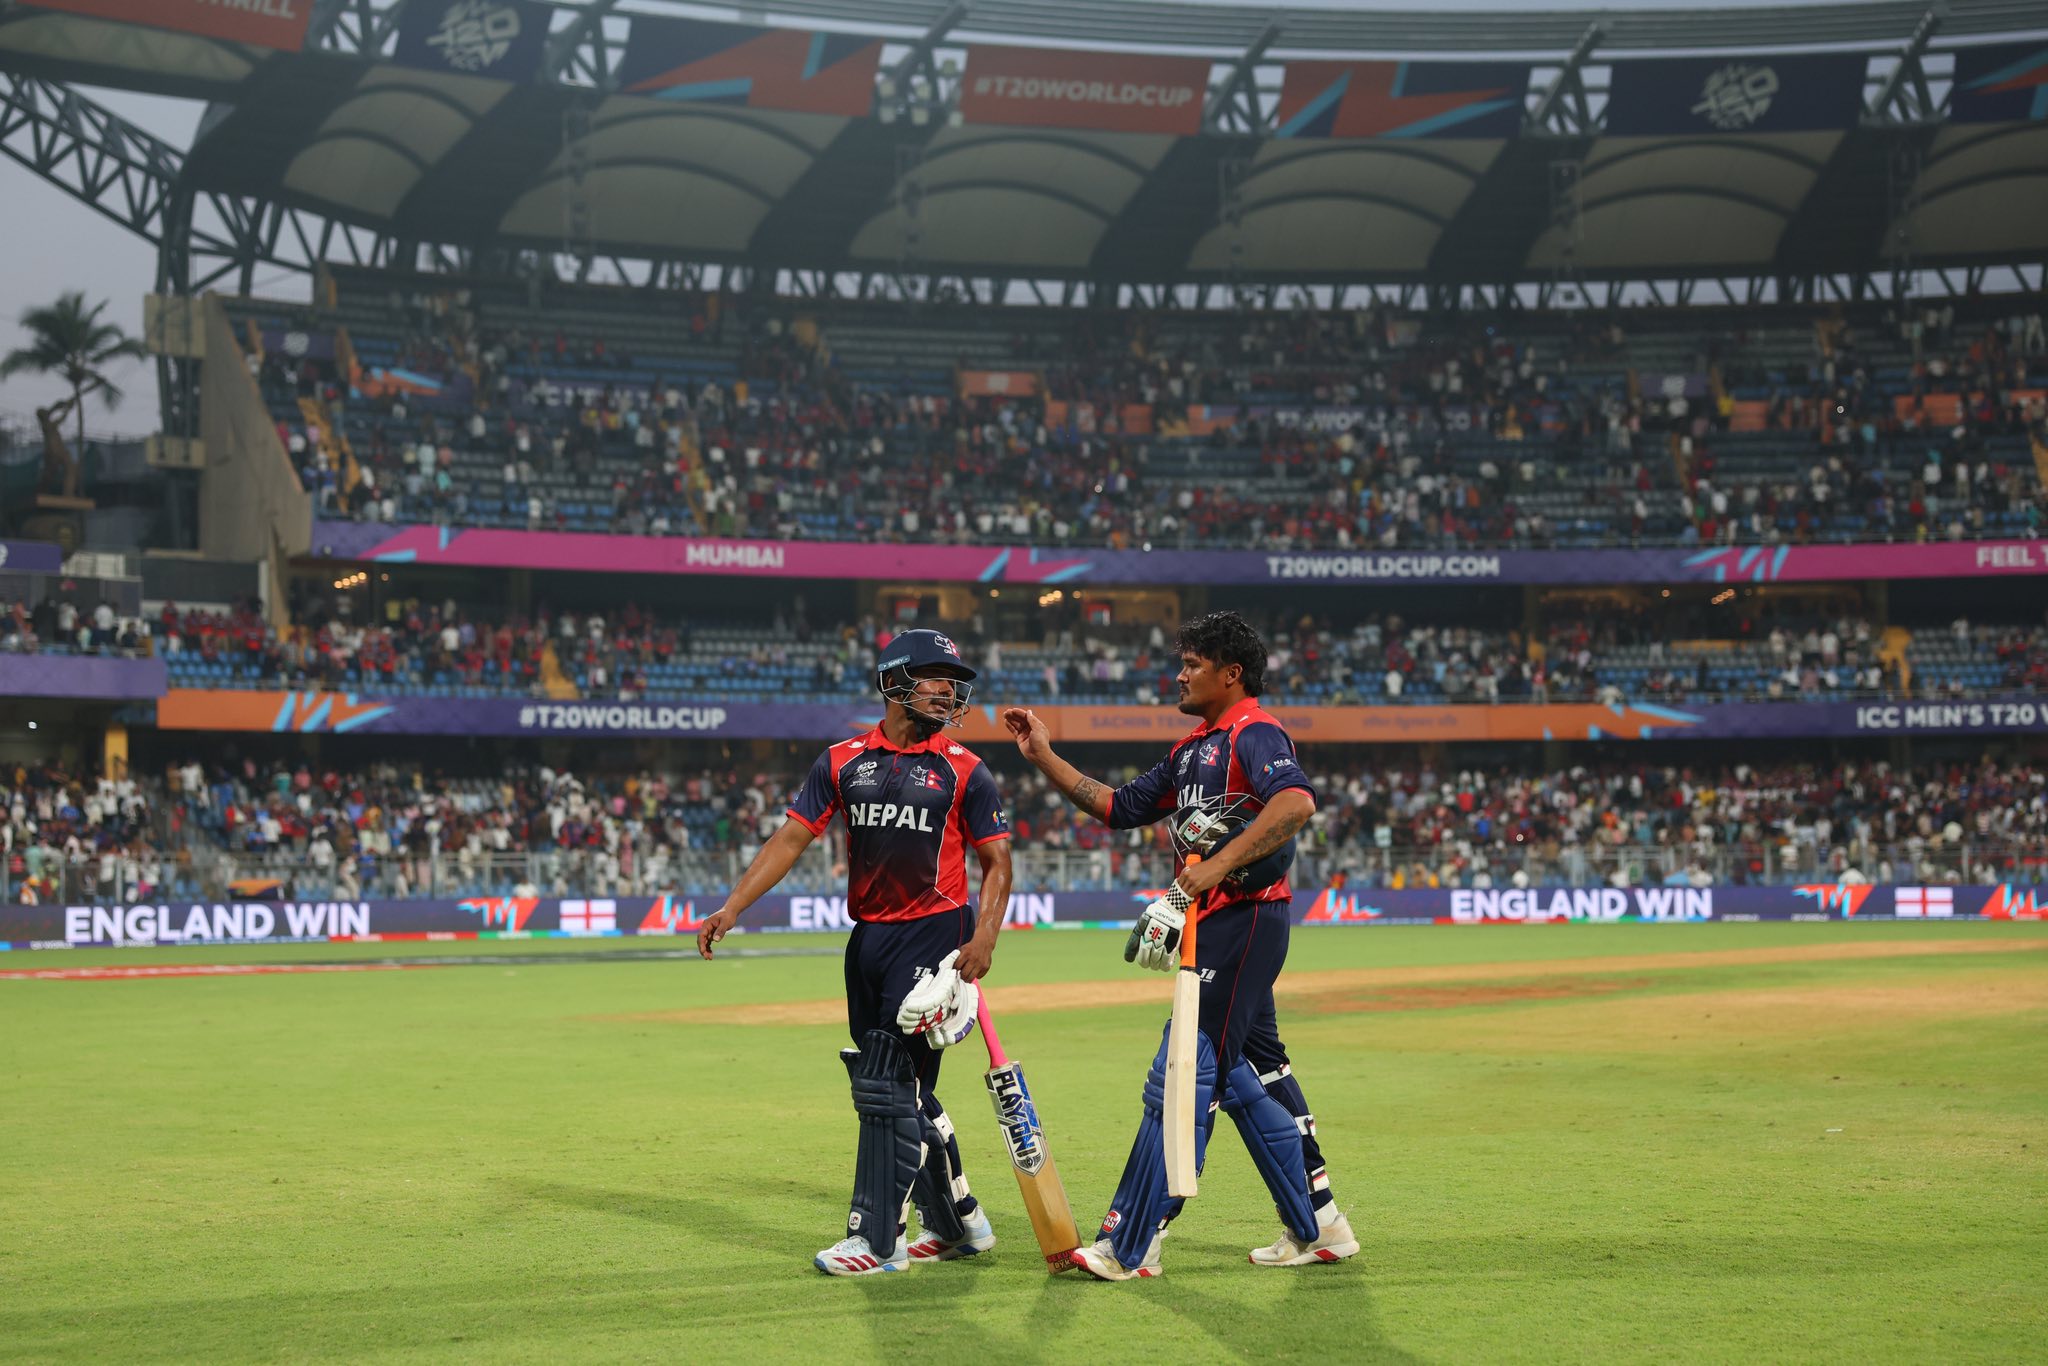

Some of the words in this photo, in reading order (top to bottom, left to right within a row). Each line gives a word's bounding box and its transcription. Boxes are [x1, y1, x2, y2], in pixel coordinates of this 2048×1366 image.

[974, 76, 1194, 108] #T20WORLDCUP
[686, 544, 785, 569] MUMBAI
[1267, 555, 1500, 578] T20WORLDCUP.COM
[1976, 545, 2037, 568] FEEL
[519, 705, 727, 730] #T20WORLDCUP
[1857, 706, 1900, 728] ICC
[1905, 705, 1985, 727] MEN'S
[1988, 703, 2037, 726] T20
[850, 802, 933, 833] NEPAL
[1450, 888, 1628, 920] ENGLAND
[1634, 887, 1712, 919] WIN
[64, 904, 276, 943] ENGLAND
[284, 902, 371, 937] WIN
